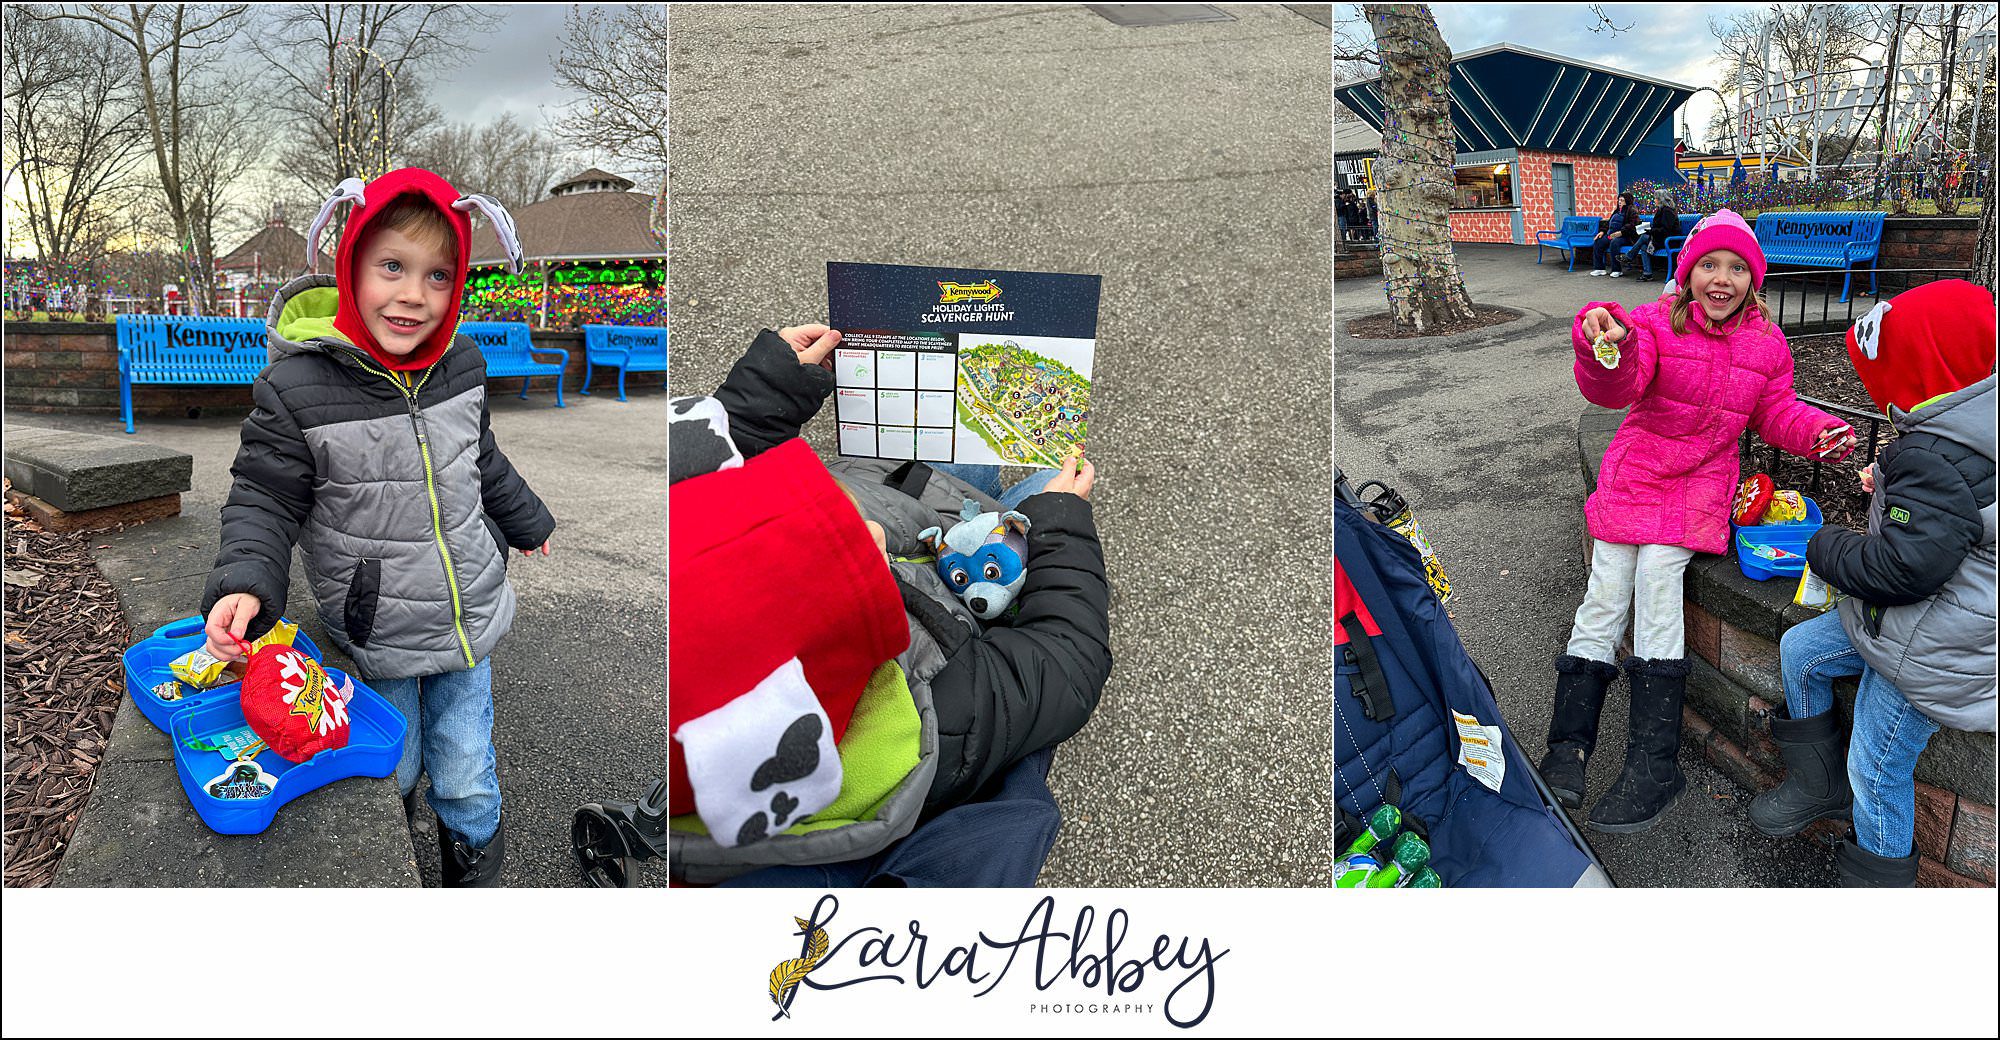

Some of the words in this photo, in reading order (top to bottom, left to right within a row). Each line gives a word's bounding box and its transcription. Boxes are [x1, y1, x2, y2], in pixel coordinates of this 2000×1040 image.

[1775, 218, 1853, 239] Kennywood
[950, 287, 991, 297] Kennywood
[932, 304, 972, 312] HOLIDAY
[974, 303, 1005, 312] LIGHTS
[921, 313, 982, 323] SCAVENGER
[985, 312, 1015, 321] HUNT
[164, 323, 268, 353] Kennywo
[606, 331, 658, 349] Kennywood
